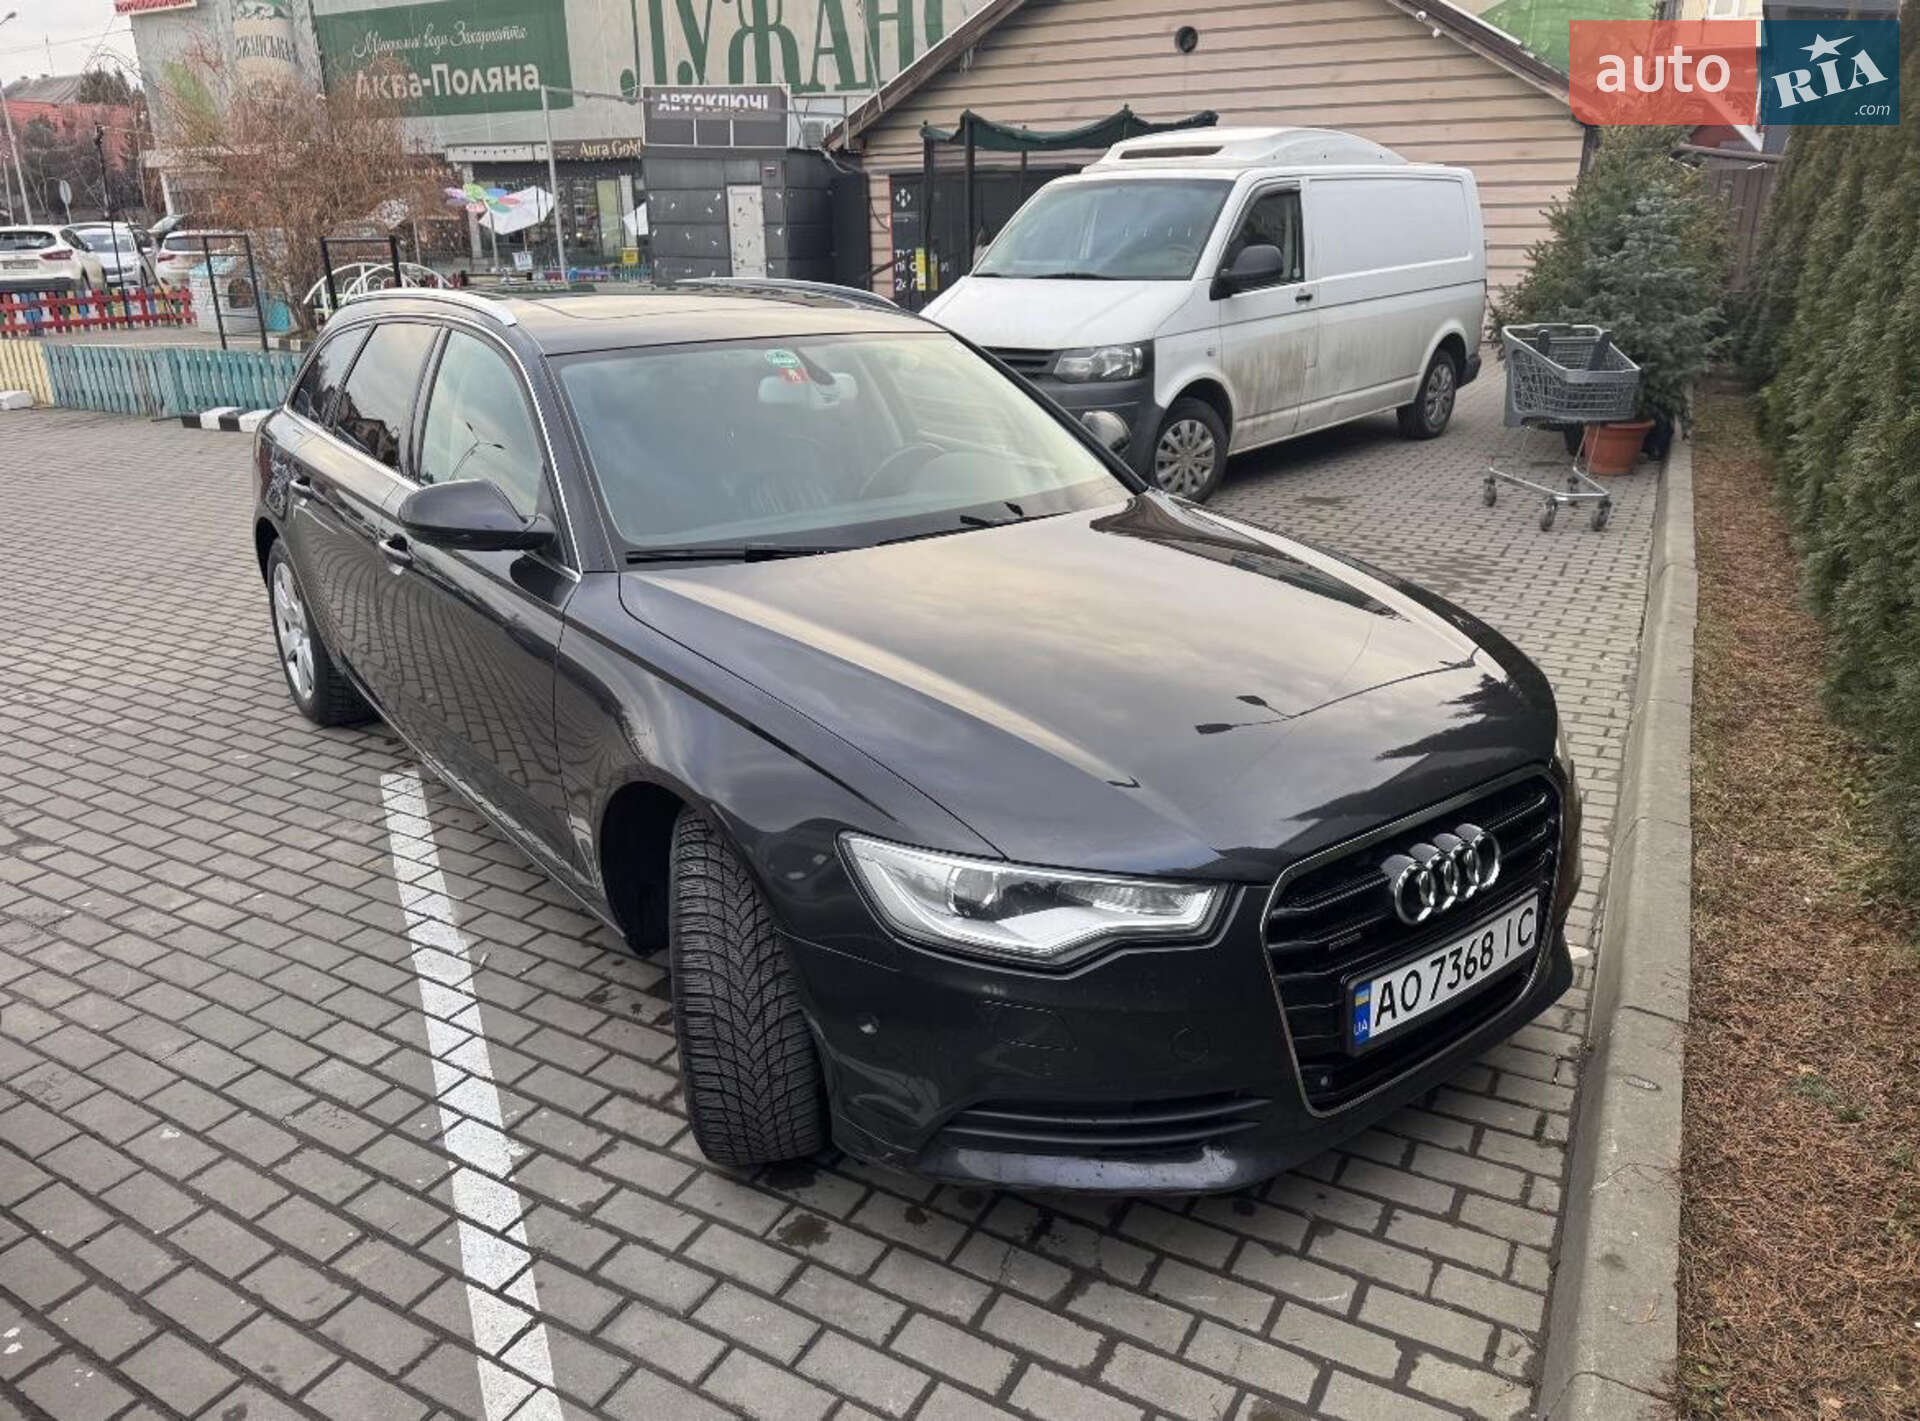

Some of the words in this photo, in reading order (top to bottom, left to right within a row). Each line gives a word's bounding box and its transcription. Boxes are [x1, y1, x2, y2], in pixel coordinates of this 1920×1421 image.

[619, 0, 946, 105] ЛУЖАН
[355, 62, 541, 100] Аква-Поляна
[657, 92, 768, 113] АВТОКЛЮЧІ
[579, 141, 610, 157] Aura
[611, 139, 642, 158] Gold
[1374, 970, 1422, 1028] AO
[1429, 930, 1495, 1001] 7368
